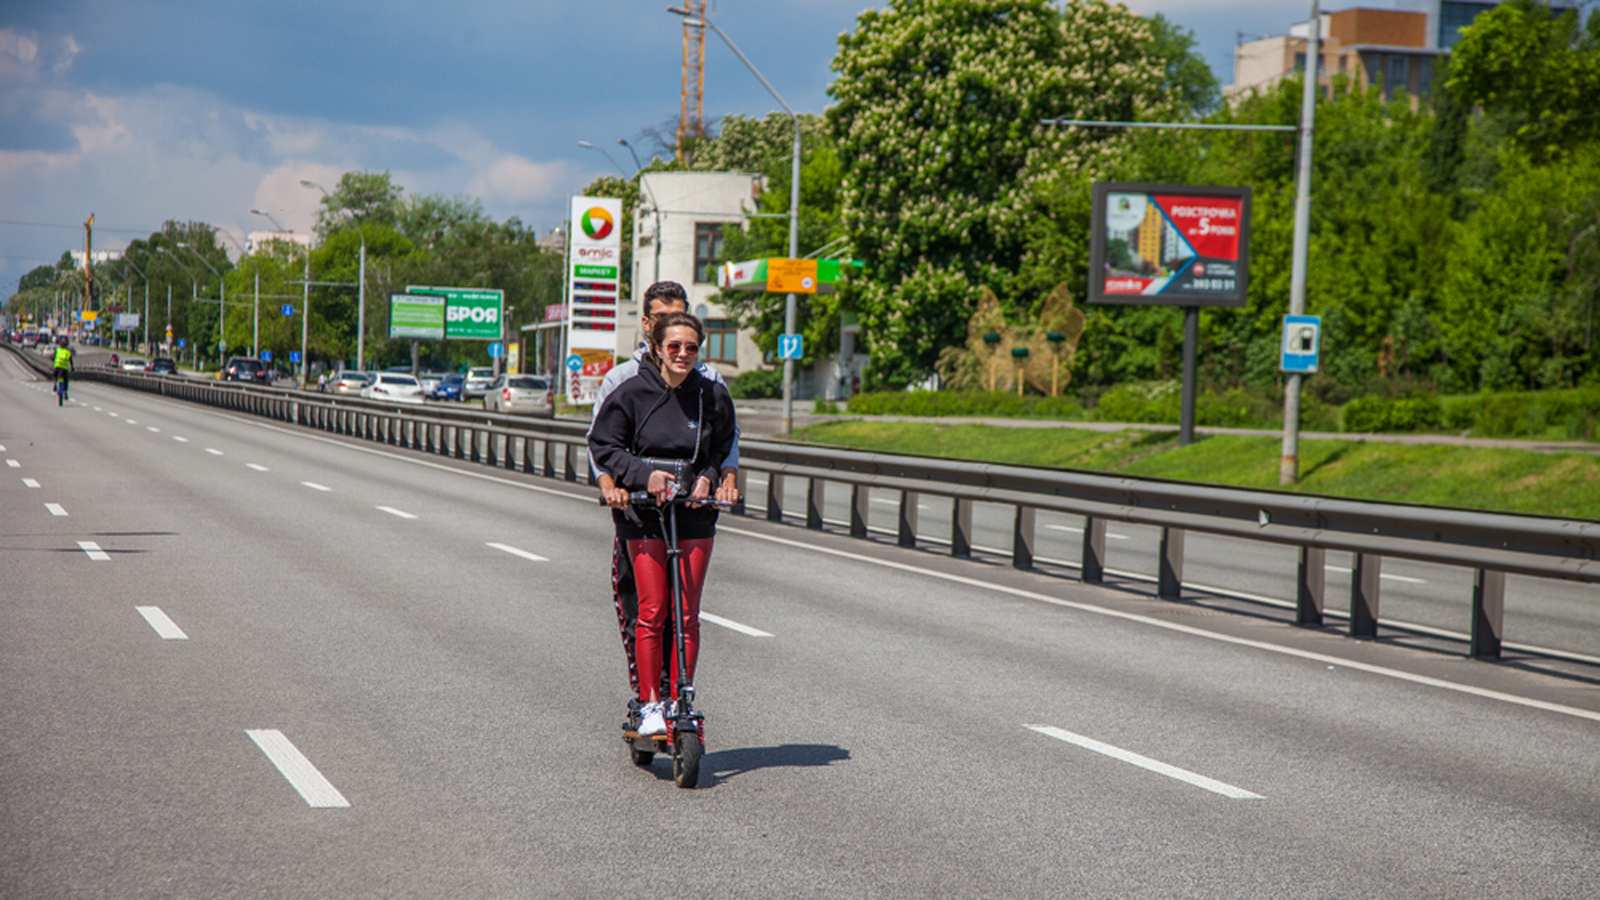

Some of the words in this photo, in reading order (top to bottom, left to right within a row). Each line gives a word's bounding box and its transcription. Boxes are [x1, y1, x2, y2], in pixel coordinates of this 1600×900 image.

[1171, 205, 1237, 218] РОЗСТРОЧКА
[1198, 217, 1211, 235] 5
[447, 305, 498, 323] БРОЯ
